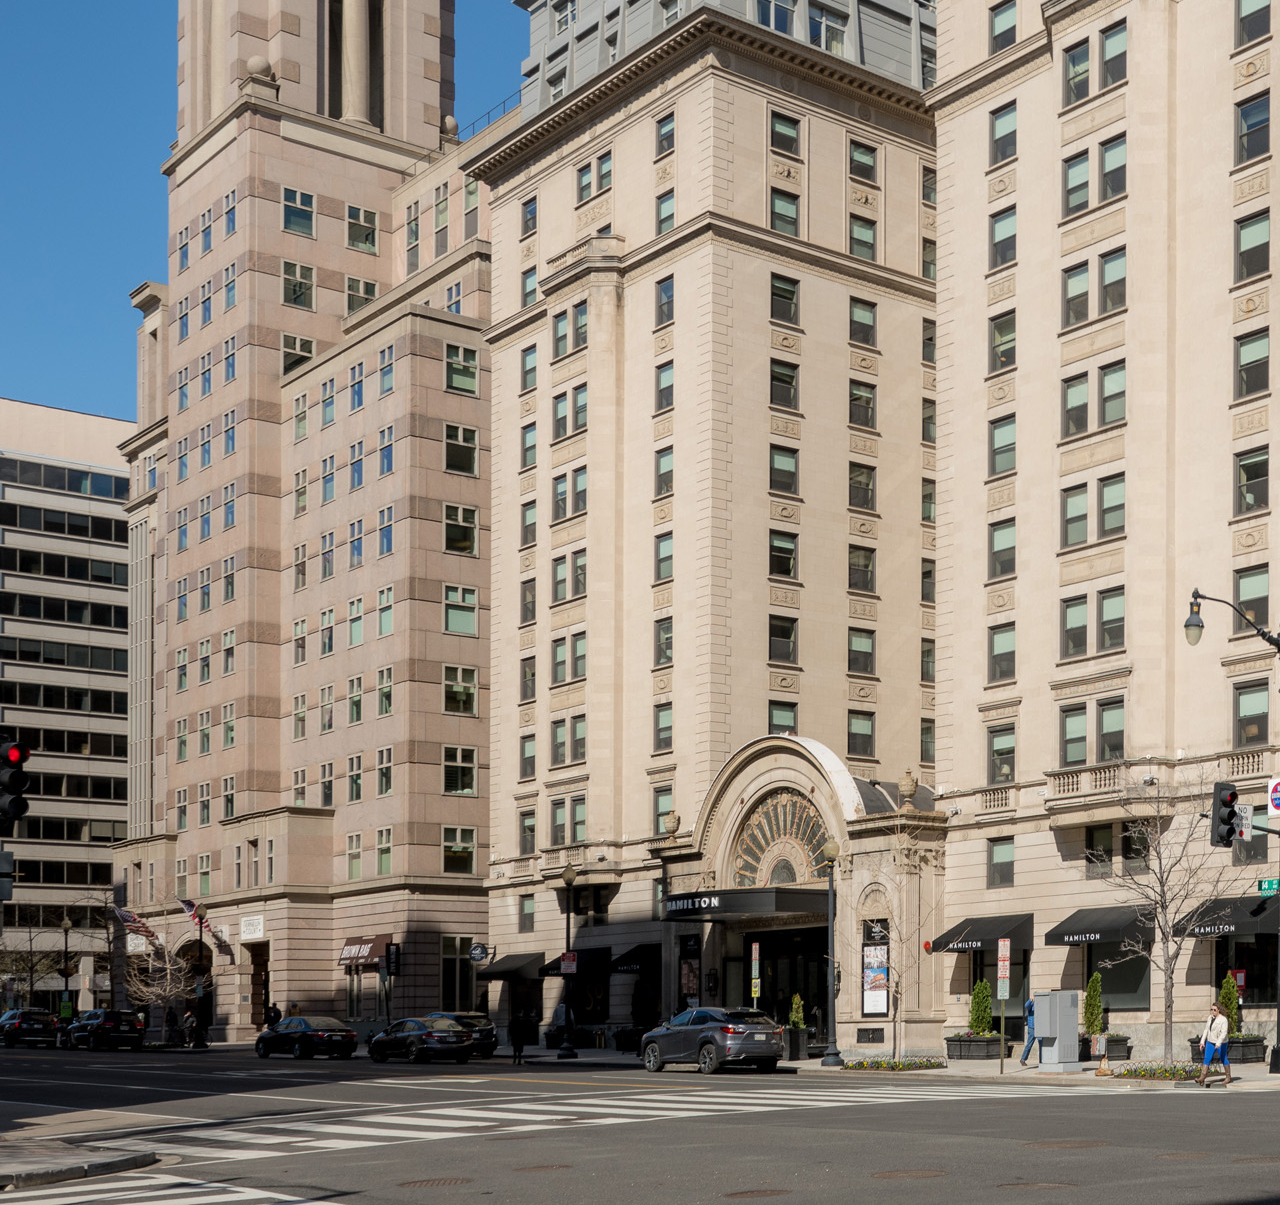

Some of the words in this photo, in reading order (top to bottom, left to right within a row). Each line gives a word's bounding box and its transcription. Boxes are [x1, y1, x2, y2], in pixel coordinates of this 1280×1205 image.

[1238, 806, 1248, 814] NO
[666, 896, 720, 912] HAMILTON
[1194, 924, 1235, 934] HAMILTON
[1064, 933, 1101, 942] HAMILTON
[949, 941, 982, 949] HAMILTON
